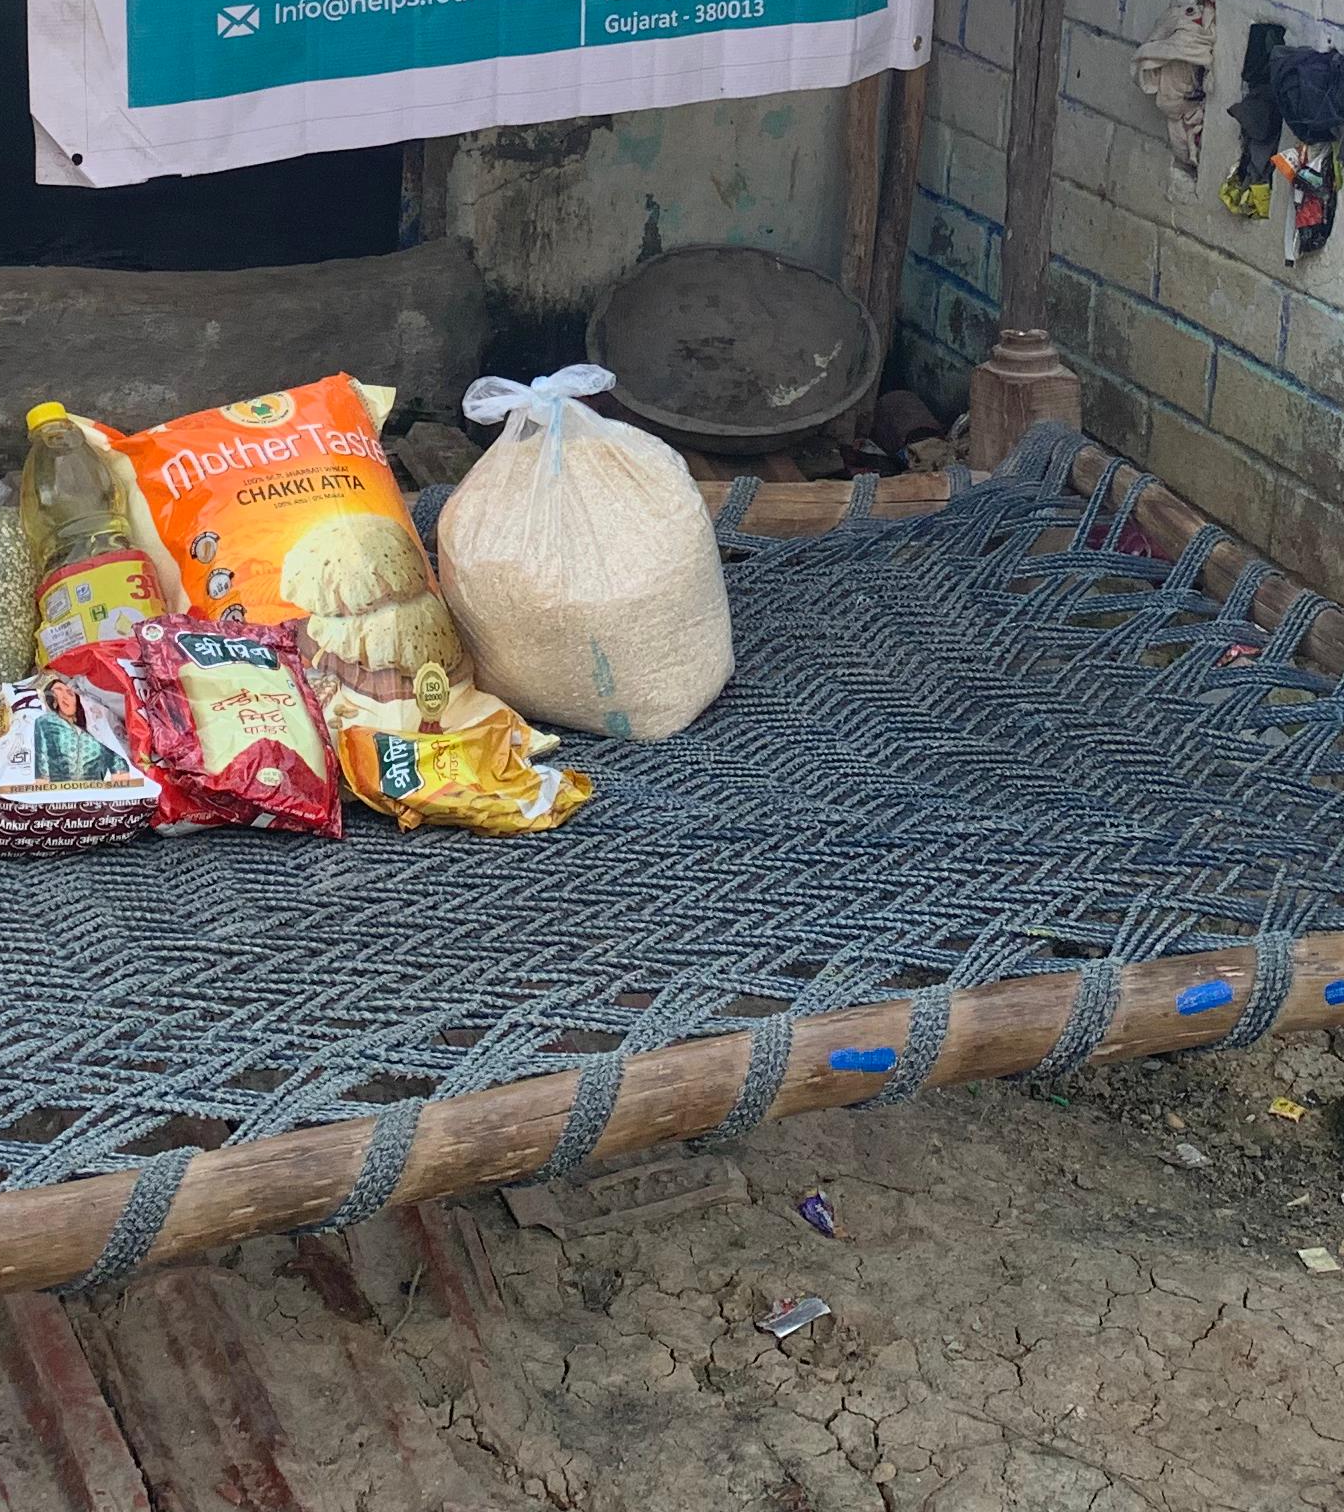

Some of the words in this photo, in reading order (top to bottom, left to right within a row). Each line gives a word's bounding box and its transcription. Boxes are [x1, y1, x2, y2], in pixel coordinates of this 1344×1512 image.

[604, 7, 679, 36] Gujarat
[160, 435, 301, 502] Mother
[296, 422, 389, 467] Taste
[236, 476, 316, 506] CHAKKI
[320, 474, 367, 491] ATTA
[425, 681, 441, 692] ISO
[0, 819, 31, 831] Ankur
[63, 818, 95, 829] Ankur
[44, 836, 76, 846] Ankur
